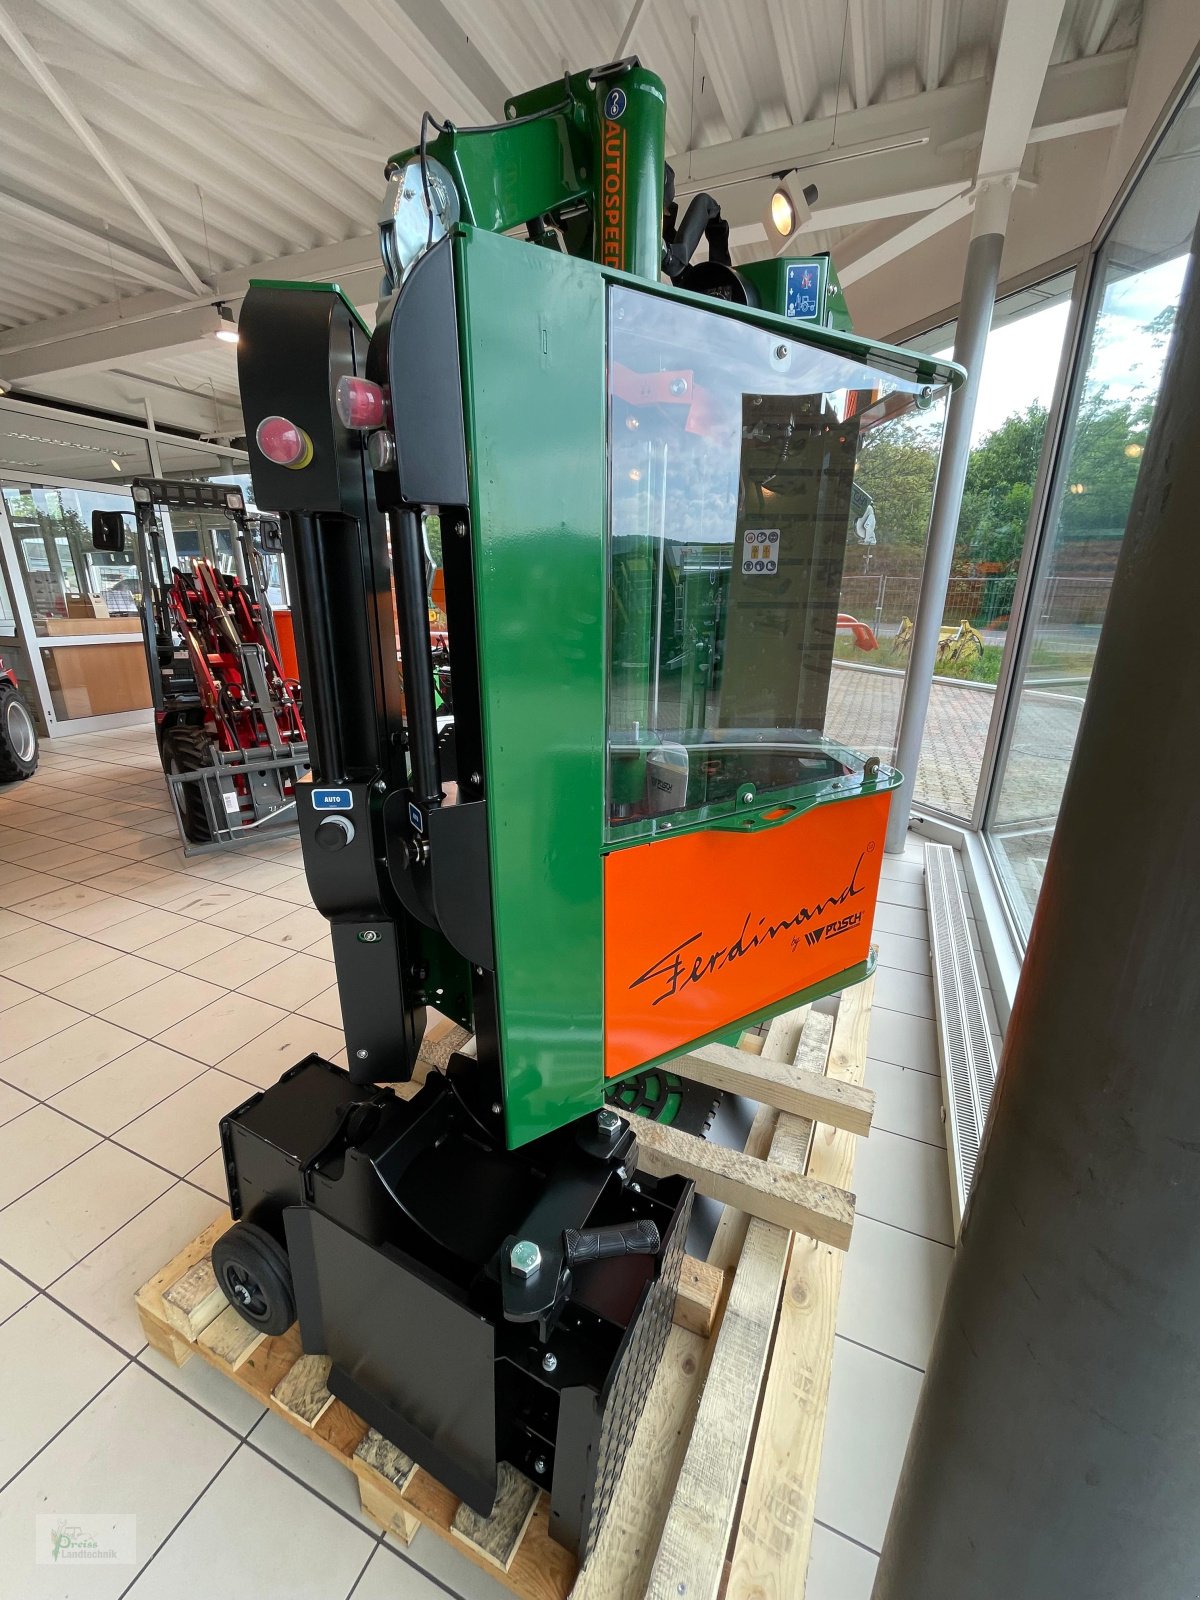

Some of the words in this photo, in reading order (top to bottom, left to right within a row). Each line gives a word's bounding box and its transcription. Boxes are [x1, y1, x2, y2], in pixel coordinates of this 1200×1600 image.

[628, 852, 865, 1006] Ferdinand
[790, 935, 801, 952] by
[825, 911, 862, 935] POSCH
